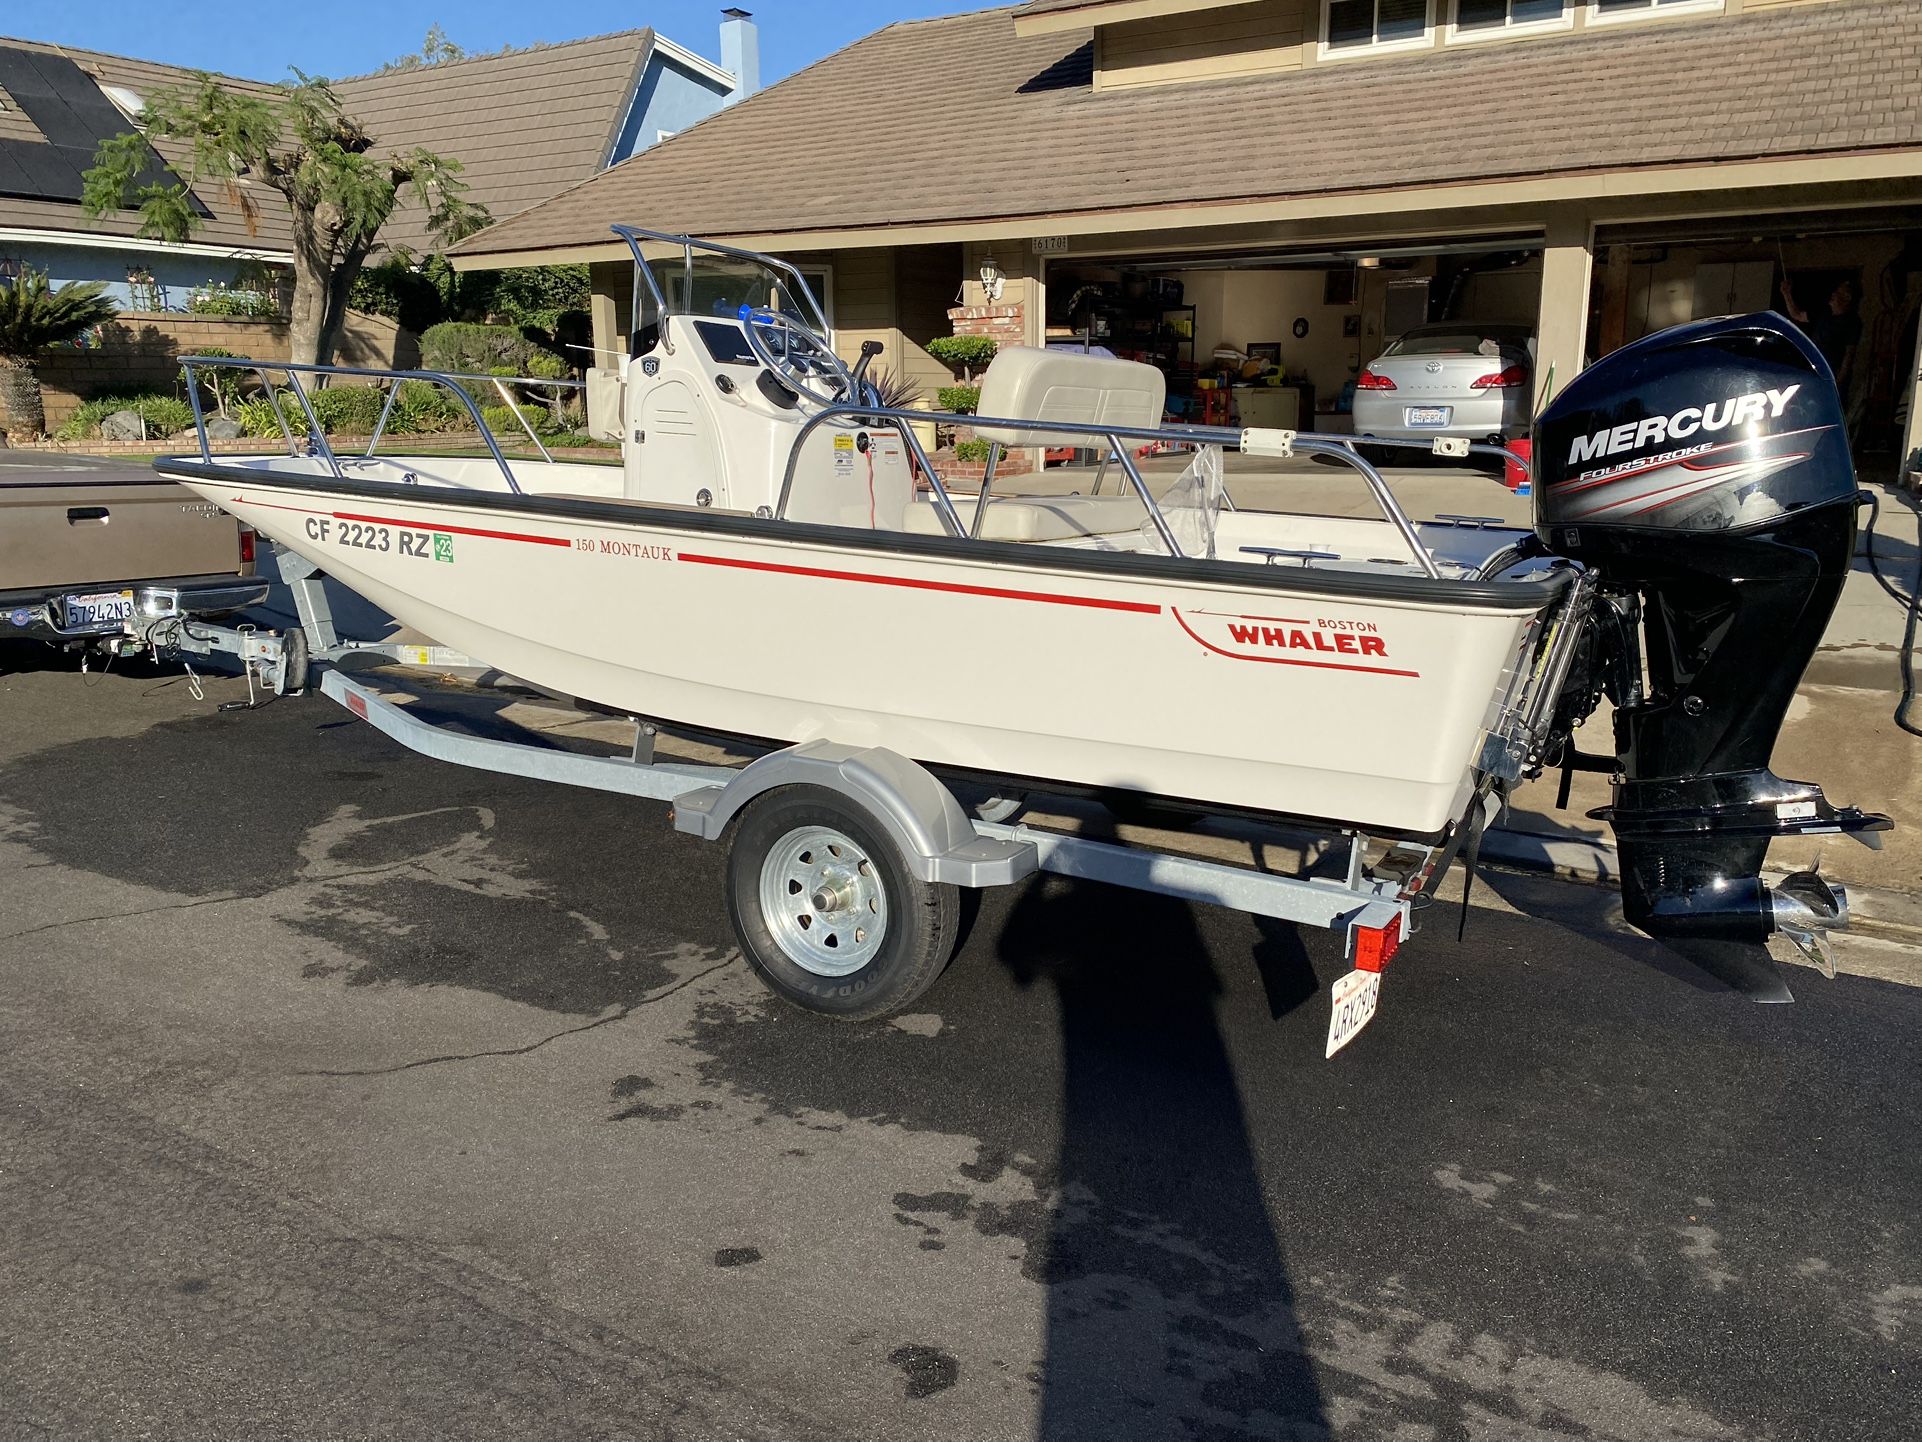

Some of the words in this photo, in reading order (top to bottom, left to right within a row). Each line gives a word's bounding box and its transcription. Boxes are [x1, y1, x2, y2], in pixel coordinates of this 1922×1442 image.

[1037, 237, 1062, 249] 6170
[645, 362, 656, 372] 60
[1568, 384, 1800, 465] MERCURY
[1579, 442, 1713, 482] FOURSTROKE
[305, 517, 330, 541] CF
[338, 522, 390, 552] 2223
[399, 530, 430, 558] RZ
[440, 539, 452, 556] 23
[576, 538, 595, 552] 150
[600, 540, 672, 561] MONTAUK
[70, 602, 132, 623] 57942N3
[1317, 618, 1377, 632] BOSTON
[1227, 624, 1389, 657] WHALER
[1334, 976, 1378, 1041] 4RX2918
